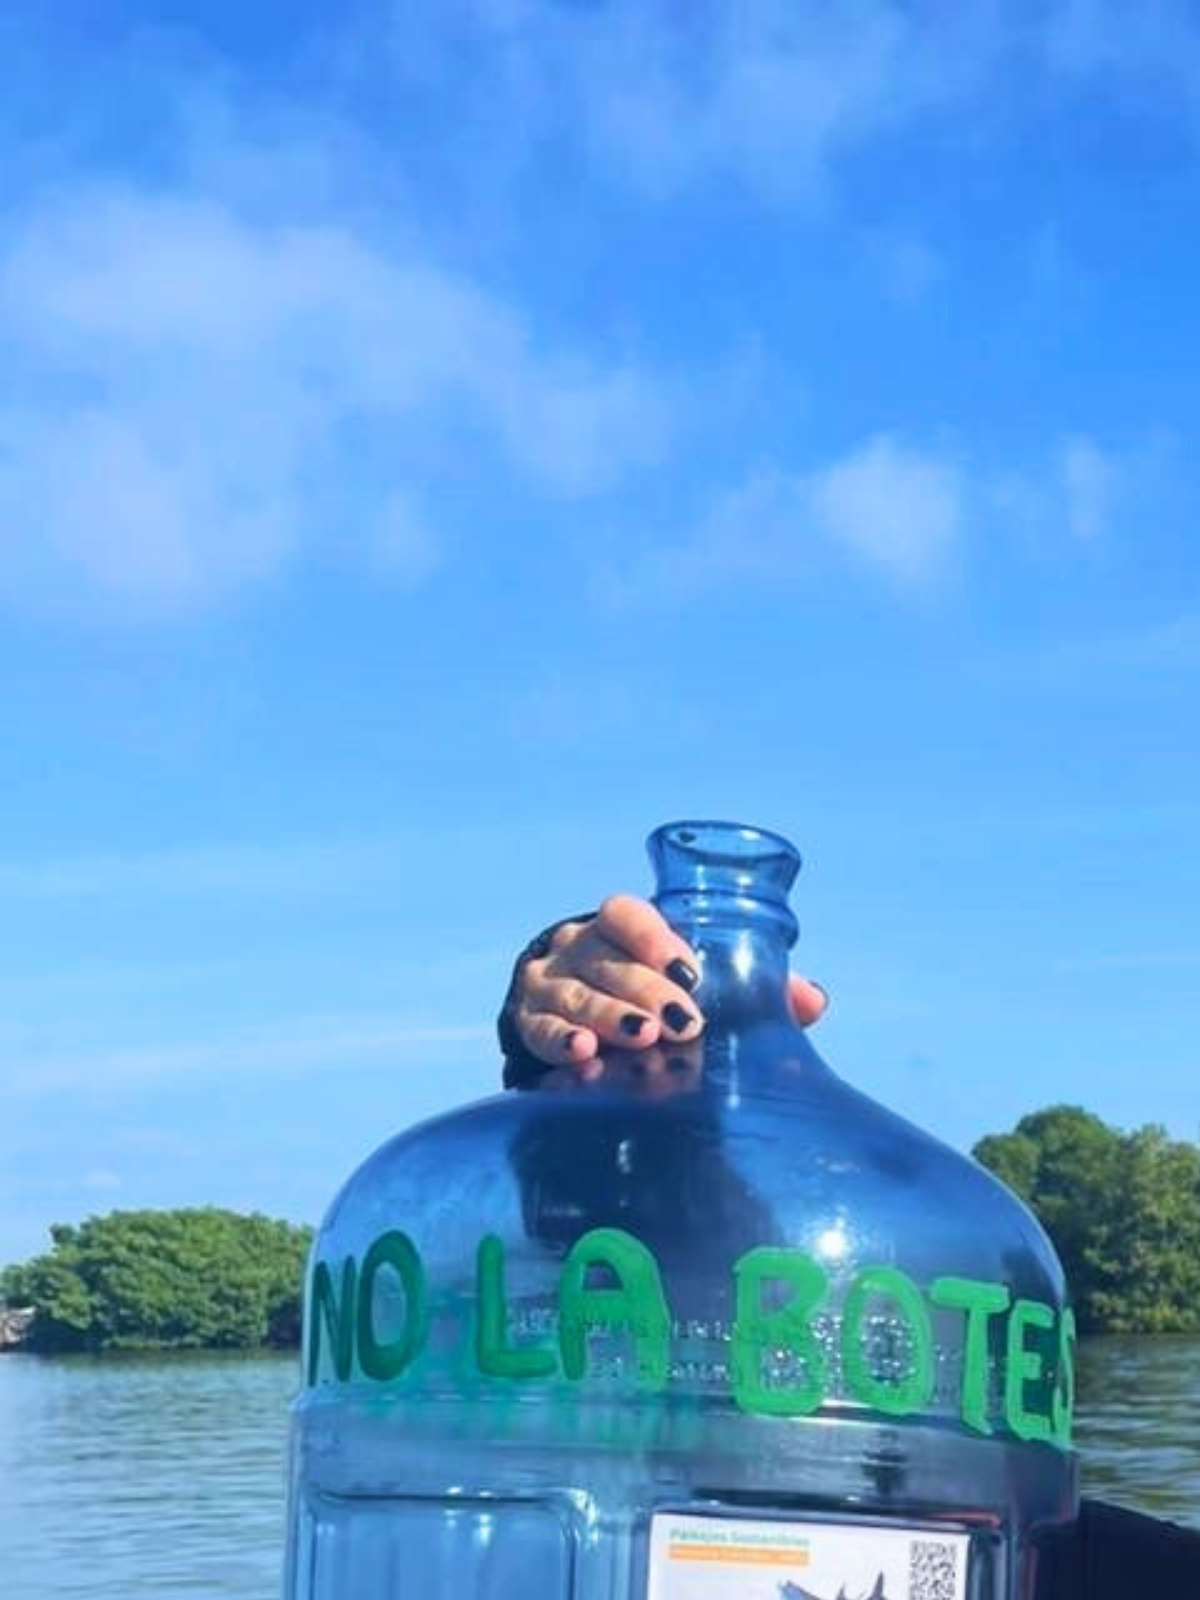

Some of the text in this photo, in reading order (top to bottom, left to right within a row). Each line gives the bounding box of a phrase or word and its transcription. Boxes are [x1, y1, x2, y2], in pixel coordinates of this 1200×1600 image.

[307, 1228, 423, 1387] NO
[475, 1227, 671, 1392] LA
[732, 1244, 1077, 1446] BOTES
